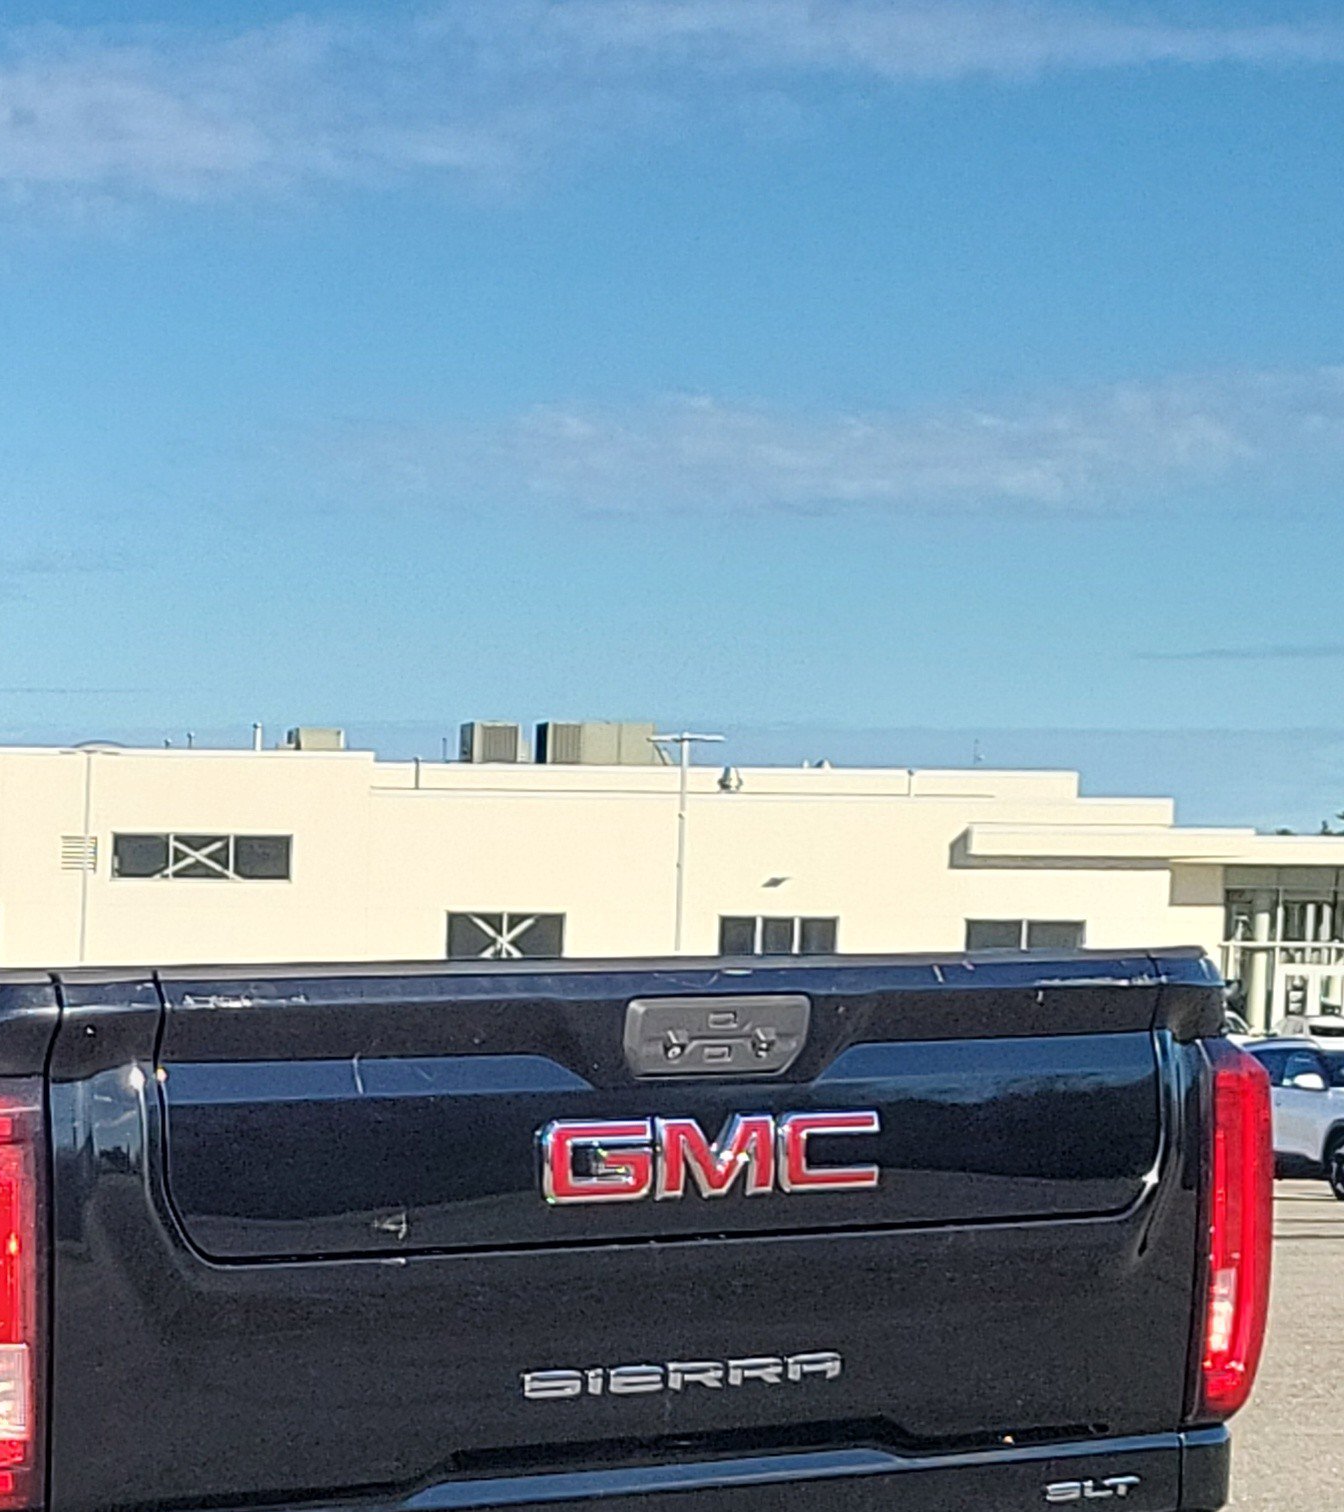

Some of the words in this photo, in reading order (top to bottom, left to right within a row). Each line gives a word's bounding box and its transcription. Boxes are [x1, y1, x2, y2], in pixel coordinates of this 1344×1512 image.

[540, 1110, 881, 1205] GMC
[522, 1351, 843, 1399] SIERRA
[1045, 1475, 1141, 1502] SLT
